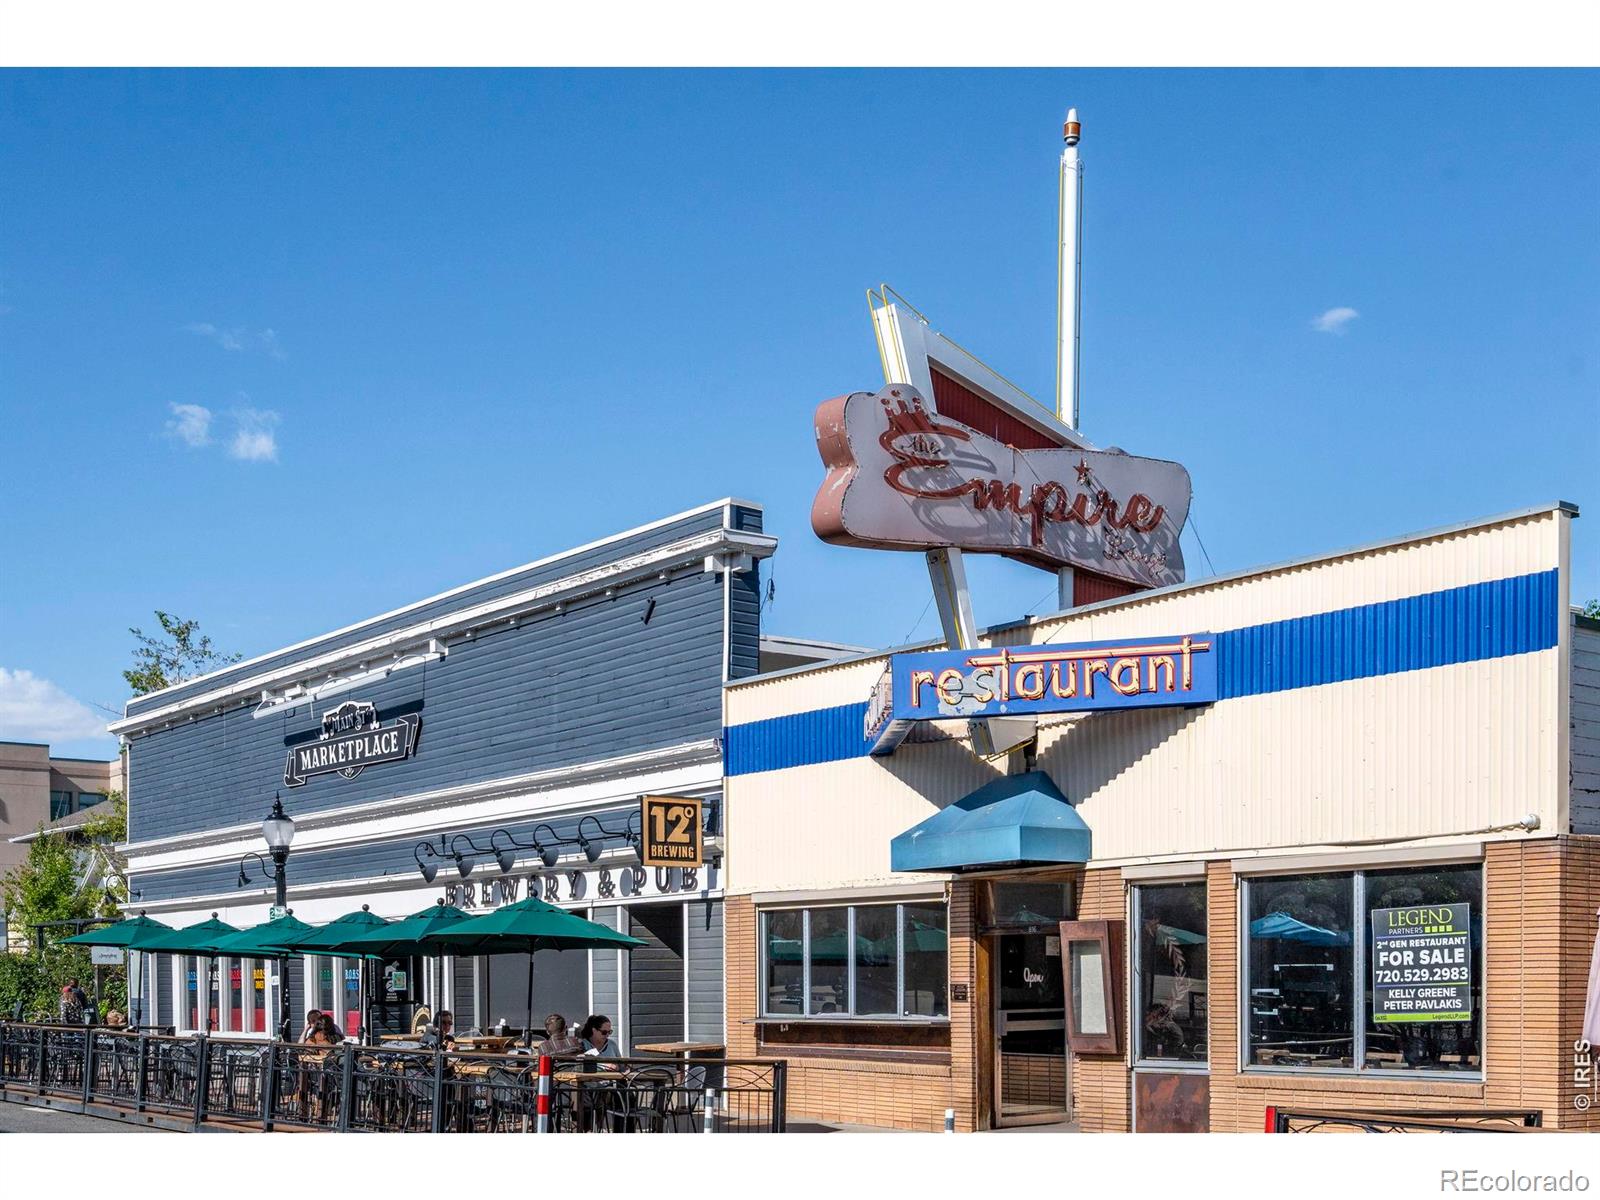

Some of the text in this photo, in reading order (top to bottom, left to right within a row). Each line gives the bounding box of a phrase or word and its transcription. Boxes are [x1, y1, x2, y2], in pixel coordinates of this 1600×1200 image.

[901, 433, 941, 454] the
[879, 422, 1165, 547] Empire
[911, 637, 1211, 708] restaurant
[300, 731, 399, 771] MARKETPLACE
[651, 845, 695, 859] BREWING
[598, 869, 616, 898] &
[631, 864, 699, 896] PUB
[1389, 908, 1453, 927] LEGEND
[1389, 927, 1423, 935] PARTNERS
[1377, 937, 1468, 949] 2nd GEN RESTAURANT
[1379, 948, 1465, 966] FOR SALE
[1023, 967, 1044, 988] Open
[1376, 967, 1469, 983] 720.529.2983
[1388, 988, 1457, 999] KELLY GREENE
[1383, 999, 1462, 1010] PETER PAVLAKIS
